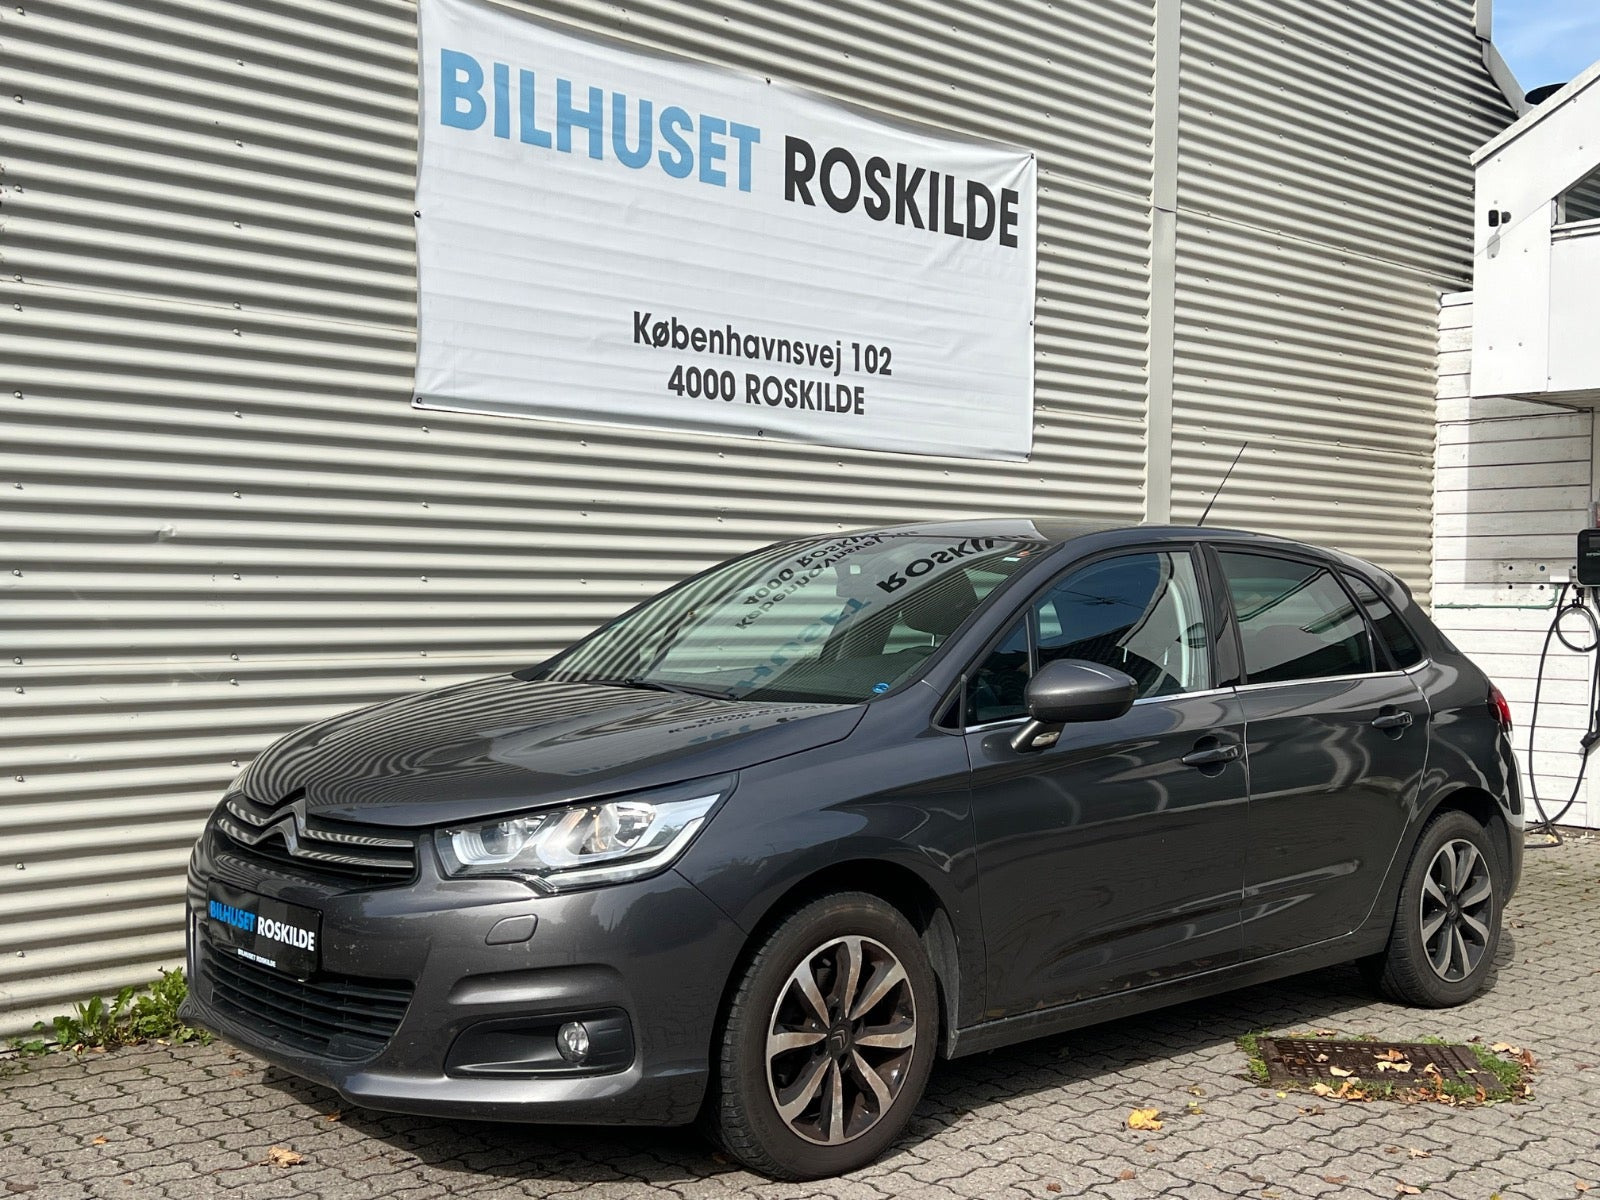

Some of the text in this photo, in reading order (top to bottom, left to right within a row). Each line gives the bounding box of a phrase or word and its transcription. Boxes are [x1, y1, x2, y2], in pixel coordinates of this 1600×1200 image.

[440, 49, 1019, 248] BILHUSET ROSKILDE
[633, 310, 892, 376] Københavnsvej 102
[667, 365, 865, 415] 4000 ROSKILDE
[209, 900, 315, 951] BILHUSET ROSKILDE
